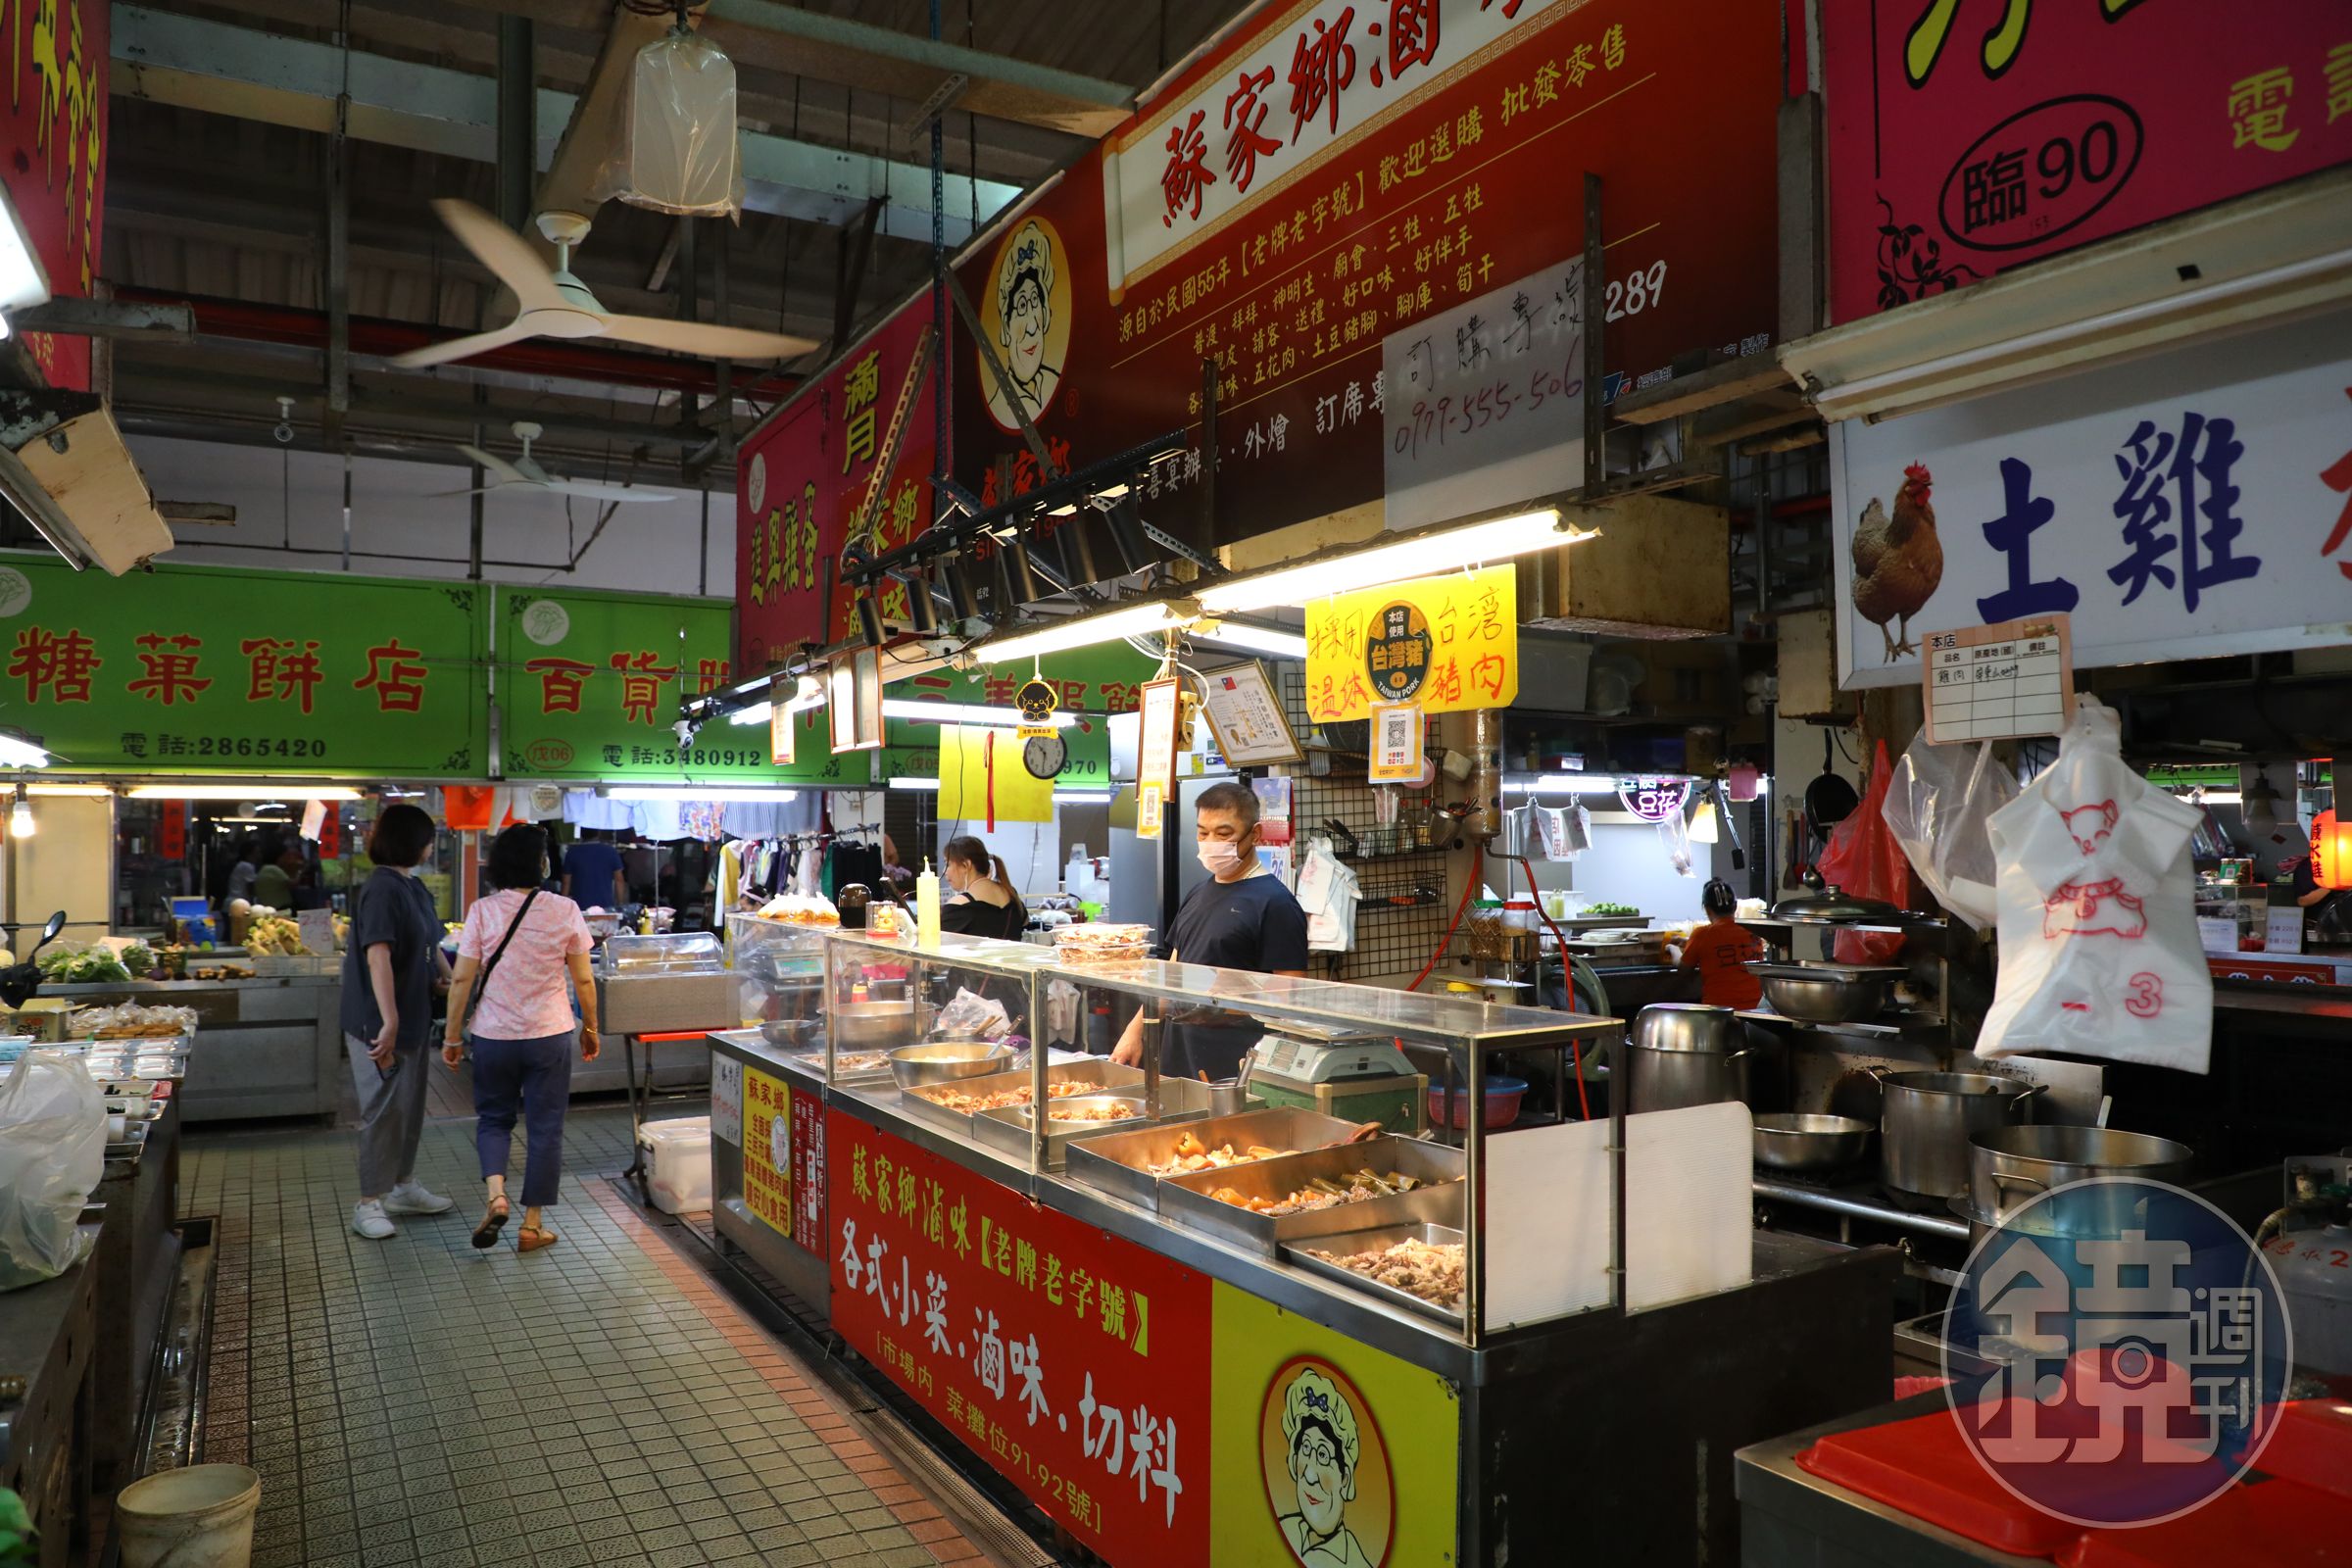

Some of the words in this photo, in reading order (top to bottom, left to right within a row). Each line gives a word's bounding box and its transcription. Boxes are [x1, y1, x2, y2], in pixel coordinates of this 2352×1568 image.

[1500, 24, 1627, 126] 批發零售
[1162, 0, 1524, 227] 蘇家鄉滷
[1963, 121, 2120, 235] 臨90
[843, 350, 880, 475] 滿月
[1395, 337, 1583, 461] 0979-555-506
[1977, 387, 2352, 624] 土雞
[1388, 611, 1404, 623] 本店
[1389, 625, 1404, 638] 使用
[1371, 639, 1424, 672] 台灣豬
[1932, 634, 1956, 649] 本店
[1944, 653, 1960, 662] 品名
[8, 625, 429, 714] 糖菓餅店
[1377, 681, 1401, 699] TAIWAN
[1401, 677, 1421, 697] PORK
[122, 732, 327, 760] 電話:2865420
[602, 743, 761, 768] 電話:3480912
[1638, 790, 1677, 814] 豆花
[2125, 971, 2164, 1019] 3
[851, 1143, 1150, 1357] 蘇家鄉滷味【老牌老字號】
